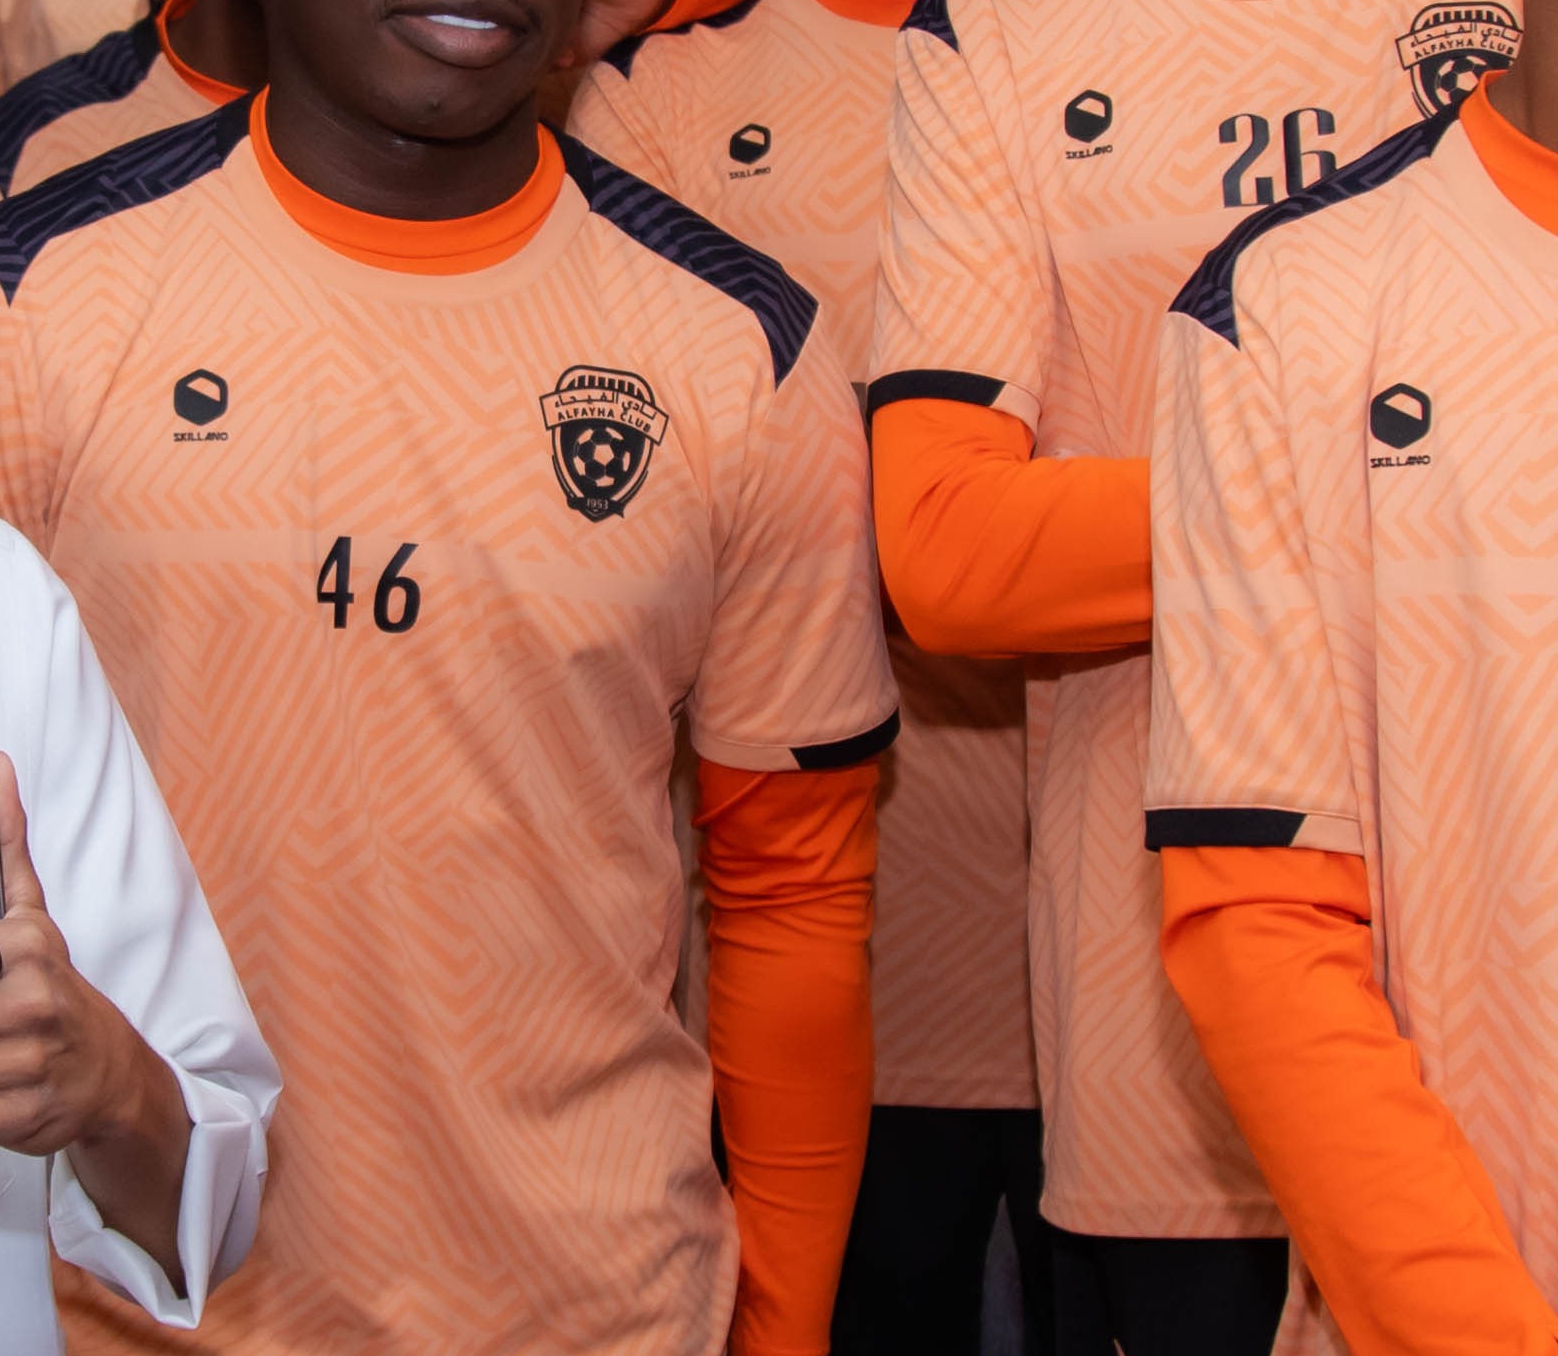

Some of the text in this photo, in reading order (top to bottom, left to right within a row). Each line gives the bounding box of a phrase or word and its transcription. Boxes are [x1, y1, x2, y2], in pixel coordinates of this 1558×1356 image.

[1414, 38, 1515, 60] ALFAYHA CLUB
[1218, 107, 1339, 209] 26
[557, 406, 652, 433] ALFAYHA CLUB
[586, 498, 609, 510] 1953
[317, 536, 421, 634] 46
